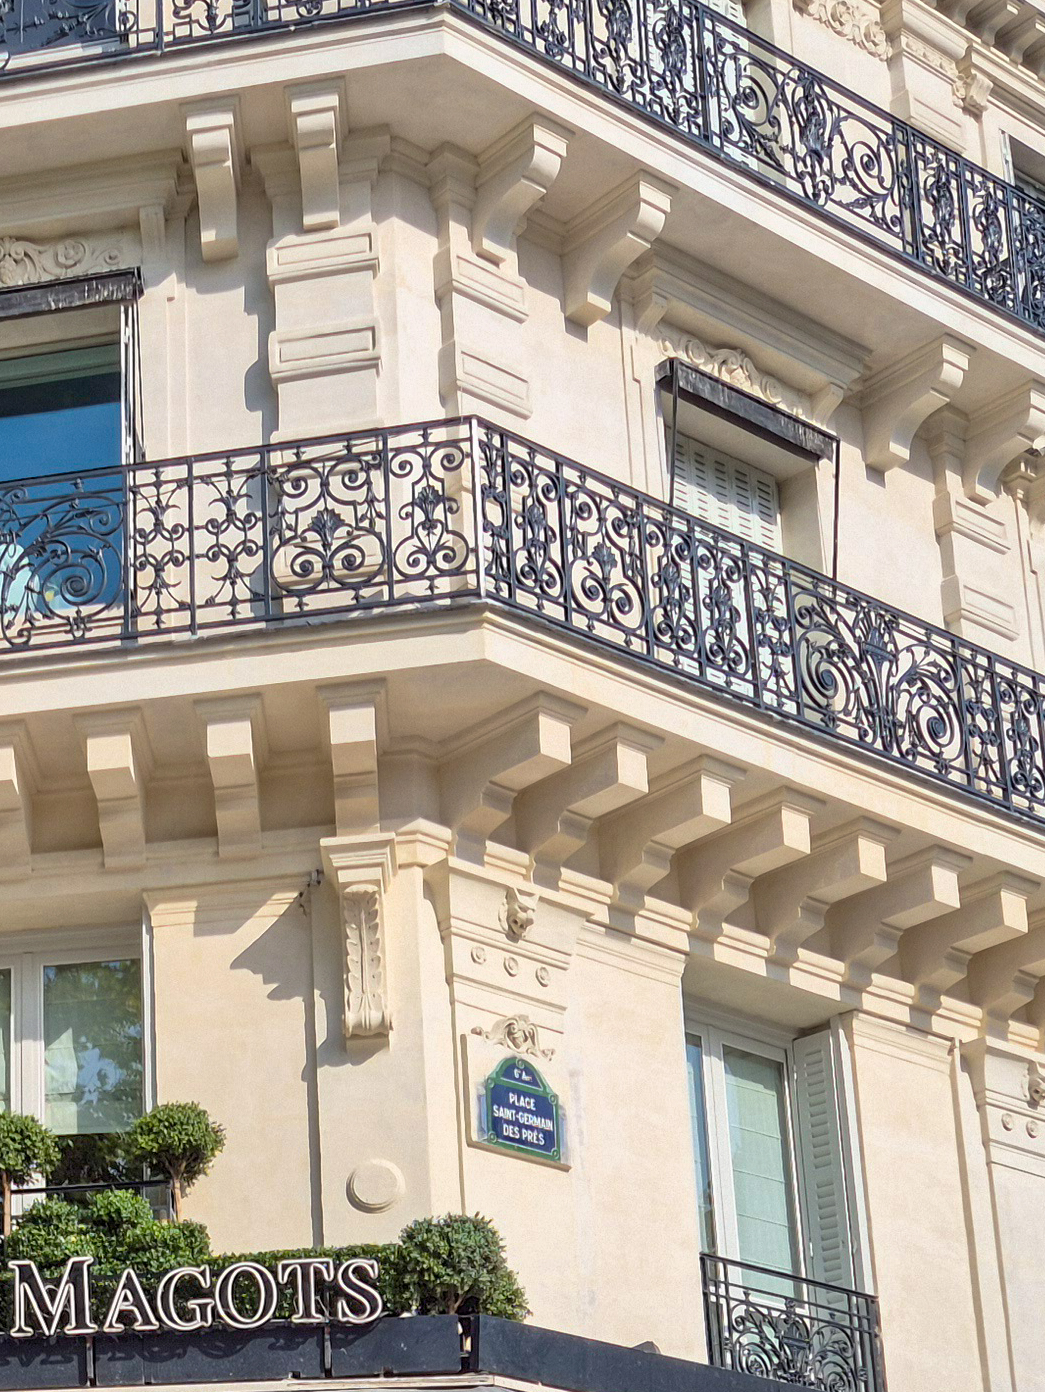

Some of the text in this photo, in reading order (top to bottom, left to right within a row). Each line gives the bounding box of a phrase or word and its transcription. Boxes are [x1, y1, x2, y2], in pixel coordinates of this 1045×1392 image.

[509, 1092, 536, 1111] PLACE
[493, 1104, 554, 1132] SAINT-GERMAIN
[503, 1124, 520, 1139] DES
[9, 1255, 384, 1338] MAGOTS
